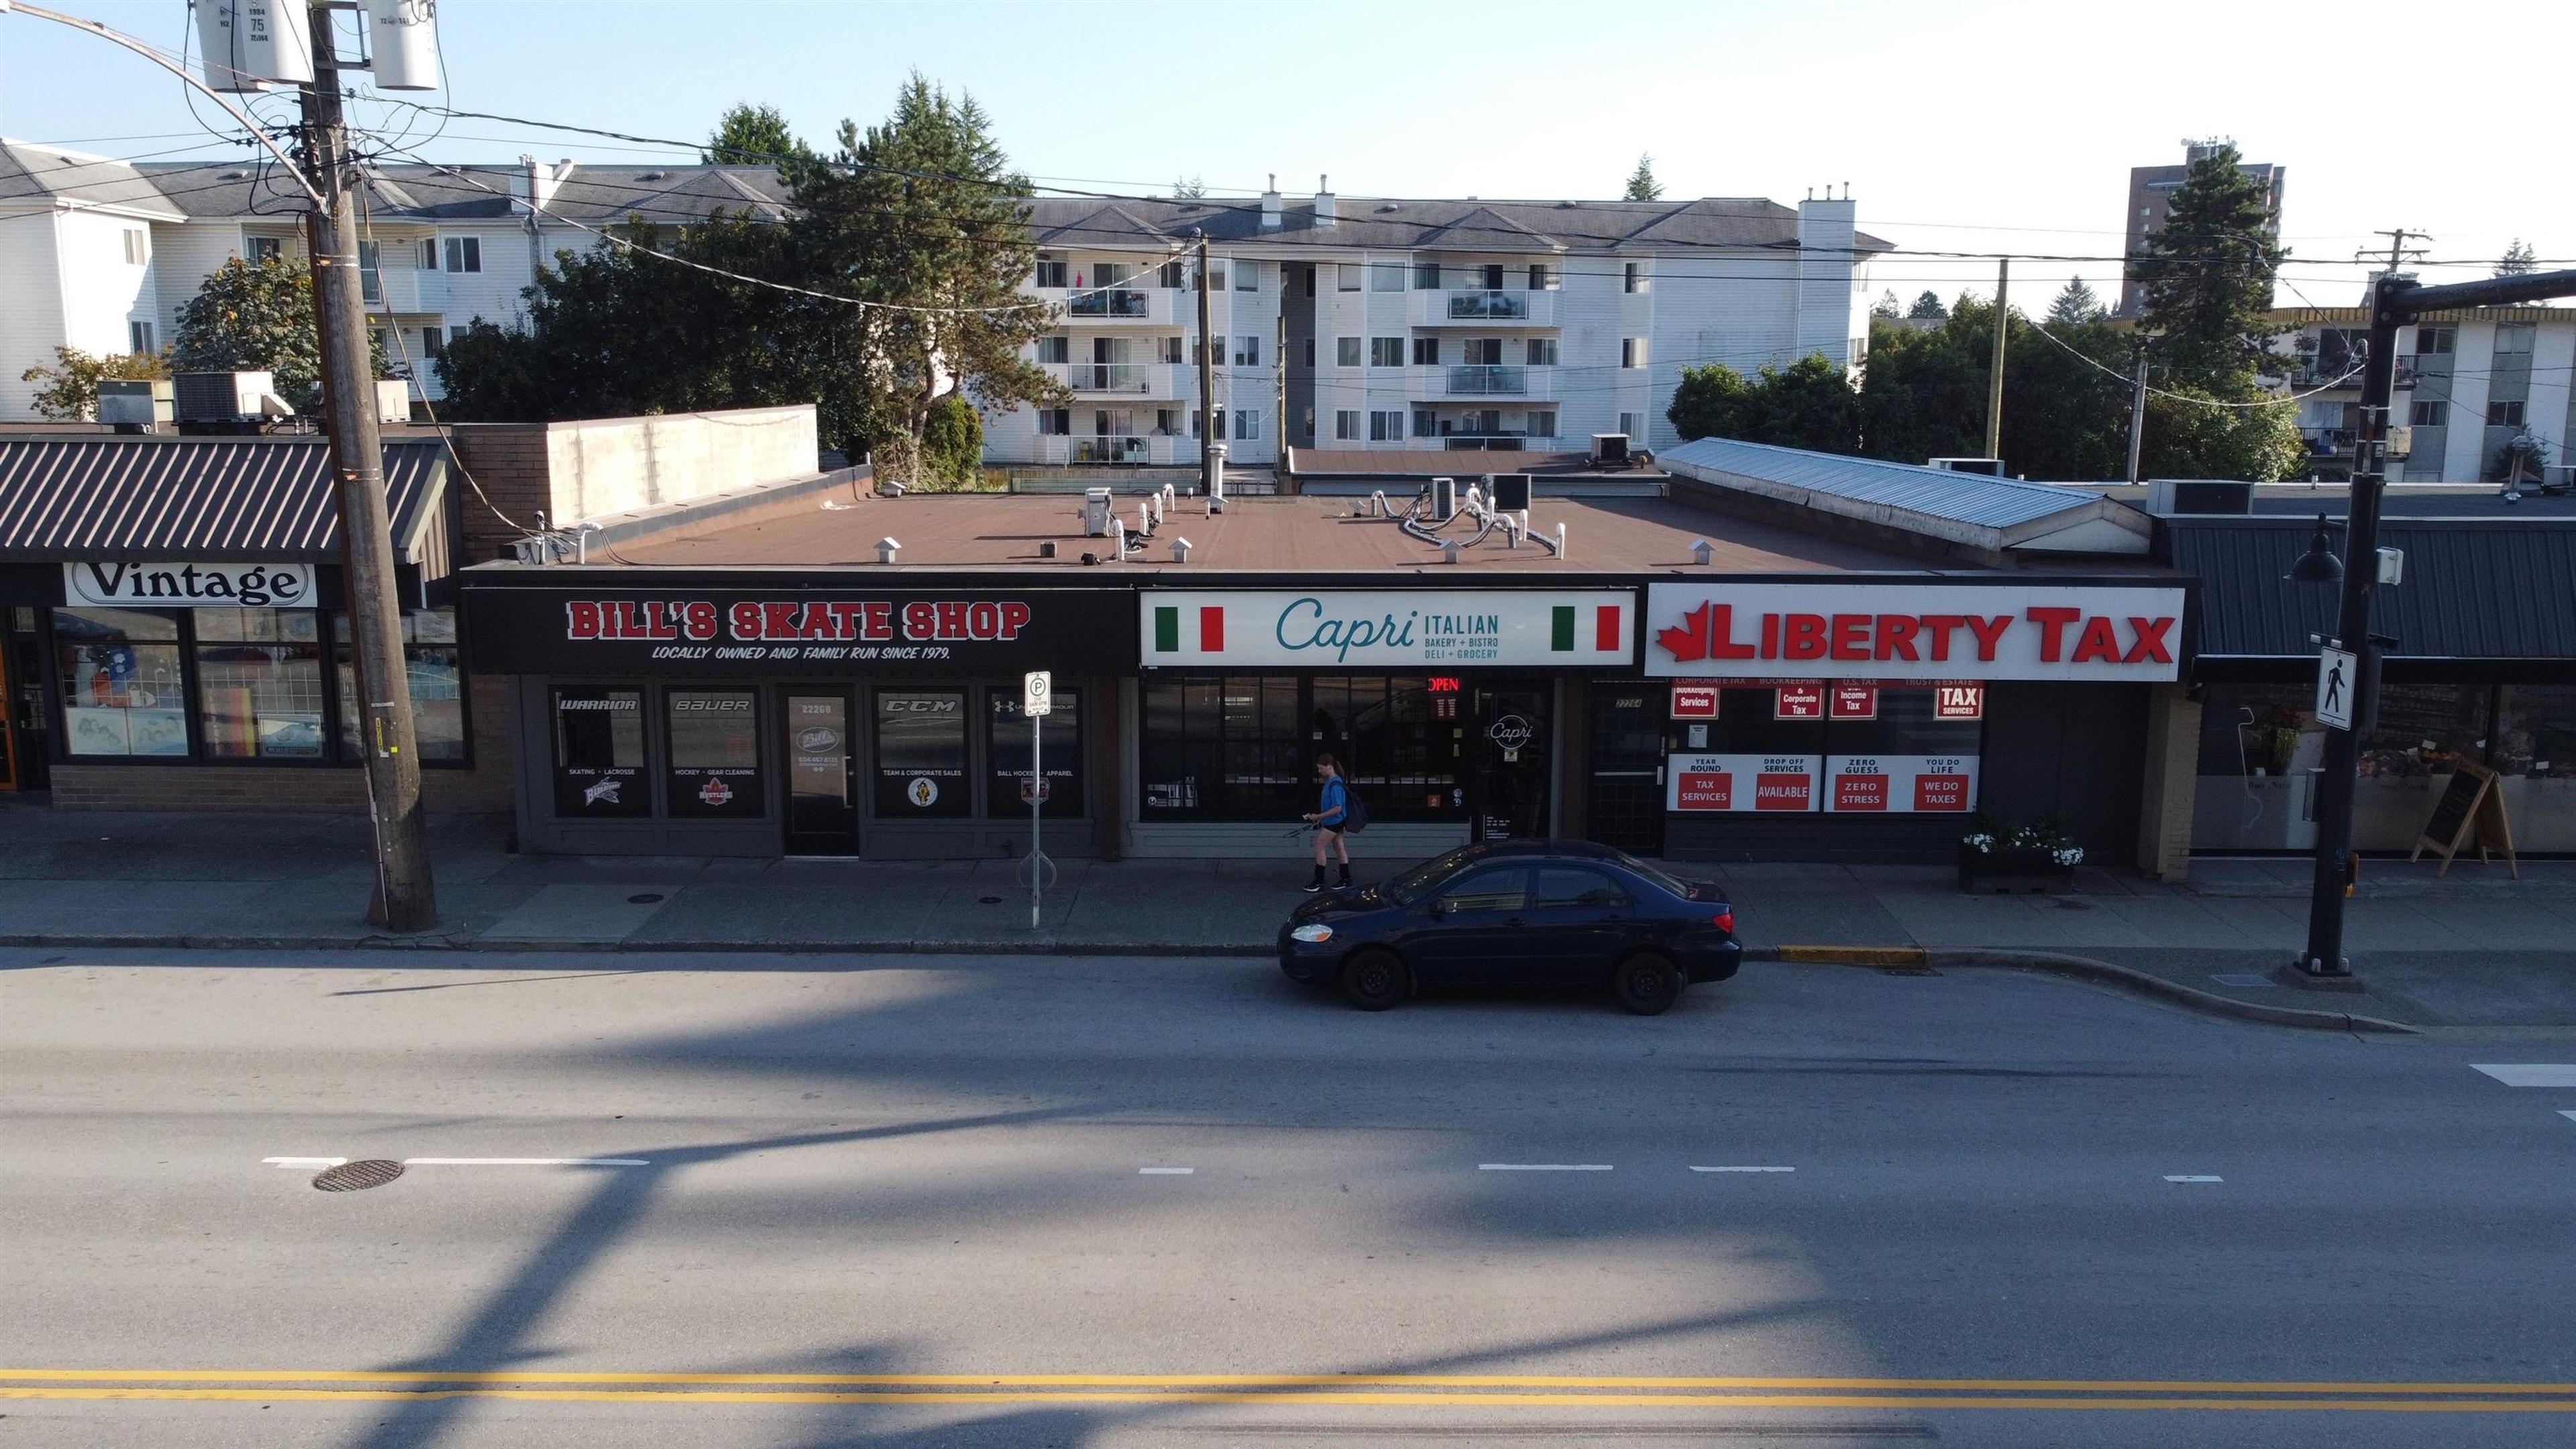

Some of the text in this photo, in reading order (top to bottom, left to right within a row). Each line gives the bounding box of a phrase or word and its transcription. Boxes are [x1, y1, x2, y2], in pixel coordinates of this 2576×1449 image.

[251, 19, 264, 32] 75
[88, 563, 300, 606] Vintage
[566, 601, 1031, 641] BILL'S SKATE SHOP
[1425, 615, 1498, 635] ITALIAN
[1276, 597, 1418, 663] Capri
[1709, 603, 2176, 665] LIBERTY TAX
[1425, 638, 1456, 647] BAKERY
[1469, 638, 1498, 647] BISTRO
[652, 646, 710, 659] LOCALLY
[716, 646, 765, 659] OWNED
[769, 646, 798, 659] AND
[803, 646, 848, 659] FAMILY
[851, 646, 879, 659] RUN
[880, 646, 919, 659] SINCE
[1425, 649, 1444, 659] DELI
[1458, 649, 1498, 659] GROCERY
[1428, 678, 1459, 692] OPEN
[1680, 697, 1709, 706] Services
[1783, 694, 1817, 703] Corporate
[1941, 688, 1977, 706] TAX
[560, 700, 637, 710] WARRIOR
[885, 700, 957, 712] CCM
[1792, 705, 1807, 714] Tax
[1846, 701, 1860, 710] Tax
[1491, 722, 1533, 742] Capri
[1696, 781, 1714, 789] TAX
[1845, 783, 1877, 791] ZERO
[1925, 782, 1958, 790] WE DO
[1682, 793, 1727, 801] SERVICES
[1758, 787, 1808, 798] AVAILABLE
[1841, 795, 1880, 804] STRESS
[1925, 795, 1957, 804] TAXES
